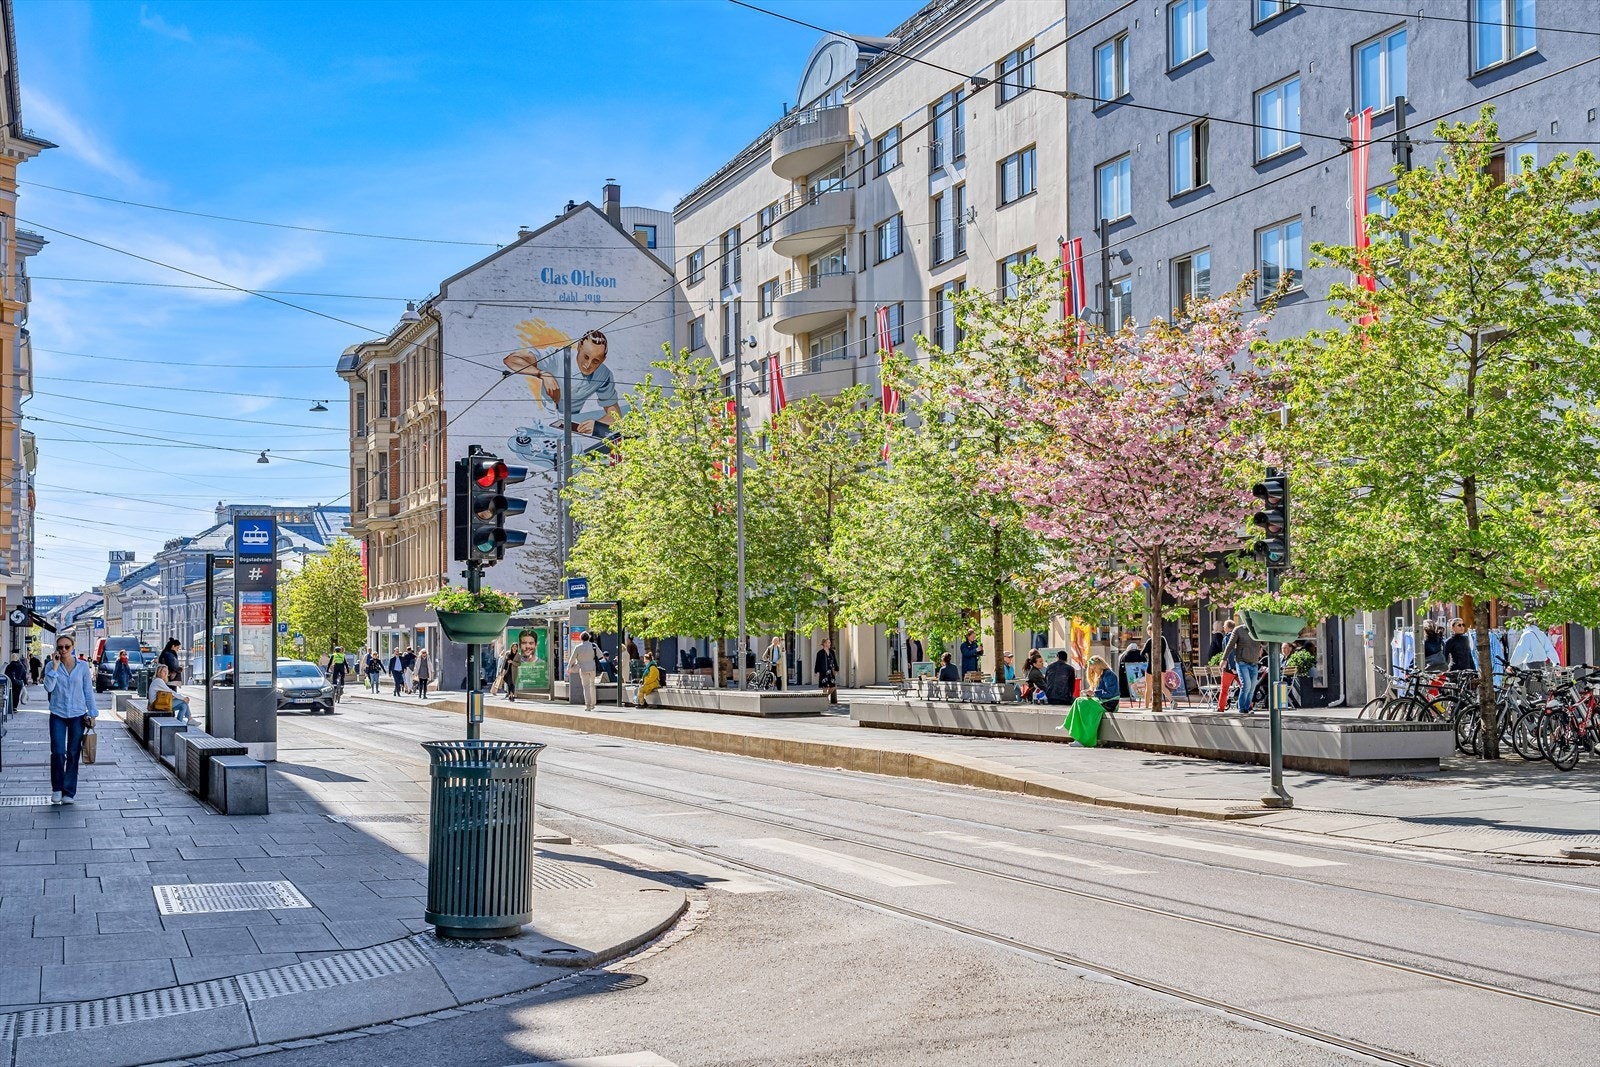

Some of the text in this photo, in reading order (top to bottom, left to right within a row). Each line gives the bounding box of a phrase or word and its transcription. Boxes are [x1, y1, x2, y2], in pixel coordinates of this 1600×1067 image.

[541, 267, 616, 288] Clas Ohlson
[584, 293, 601, 304] 1918
